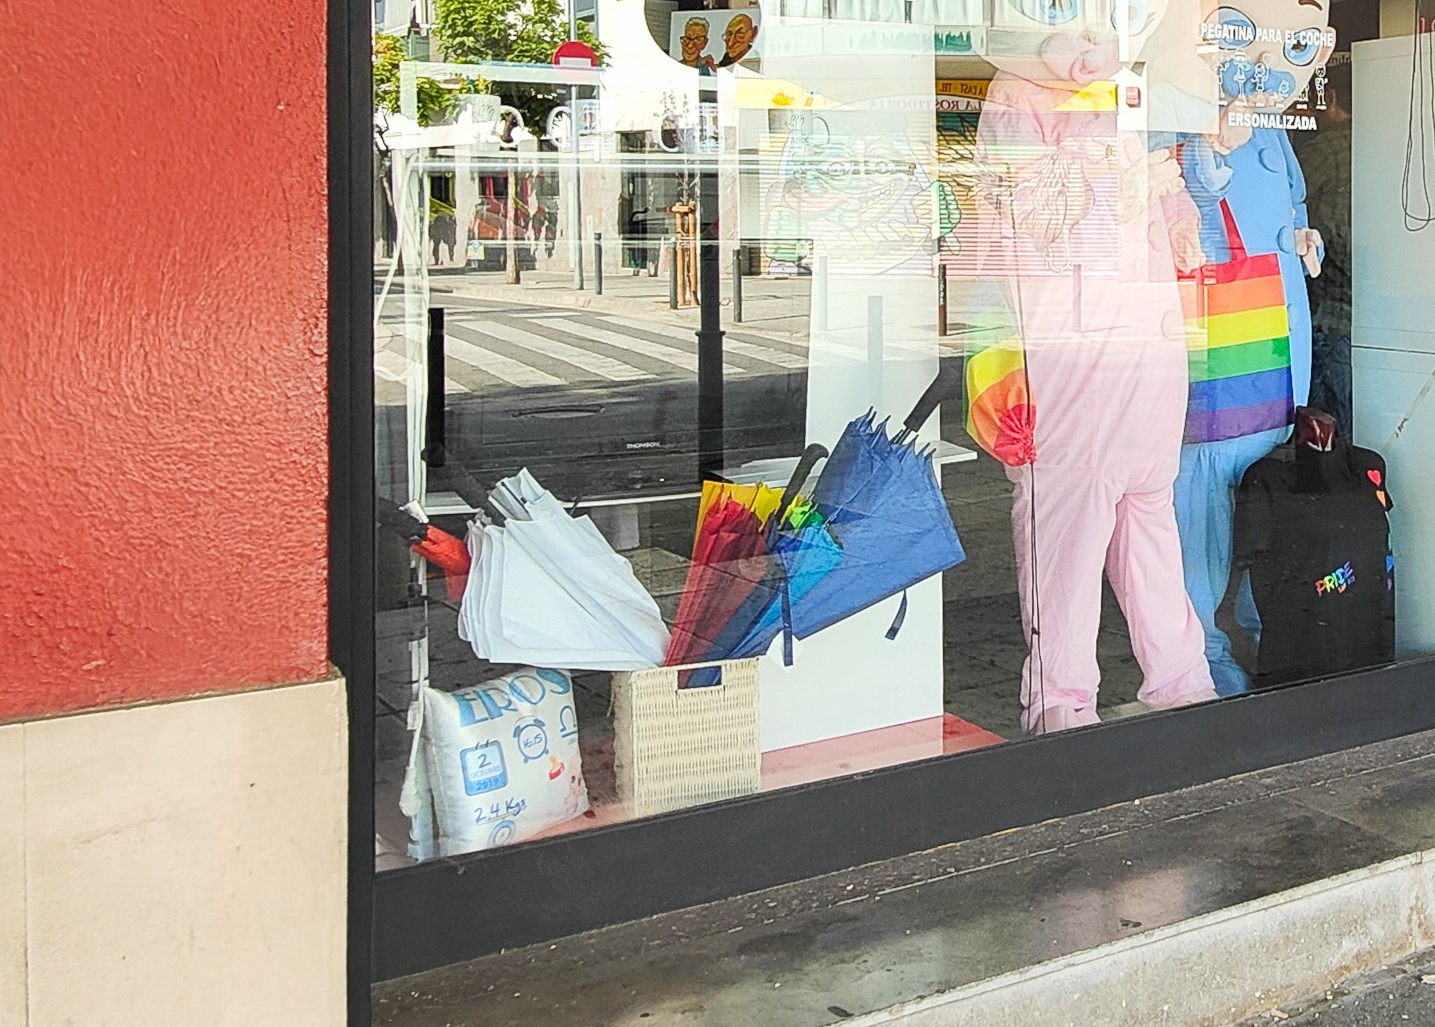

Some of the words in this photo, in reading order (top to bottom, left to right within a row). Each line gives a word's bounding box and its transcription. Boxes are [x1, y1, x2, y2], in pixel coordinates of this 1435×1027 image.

[1201, 23, 1253, 41] PEGATINA
[1256, 28, 1282, 43] PARA
[1285, 30, 1297, 44] EL
[1299, 31, 1334, 47] COCHE
[452, 668, 571, 727] EROS
[478, 753, 492, 769] 2
